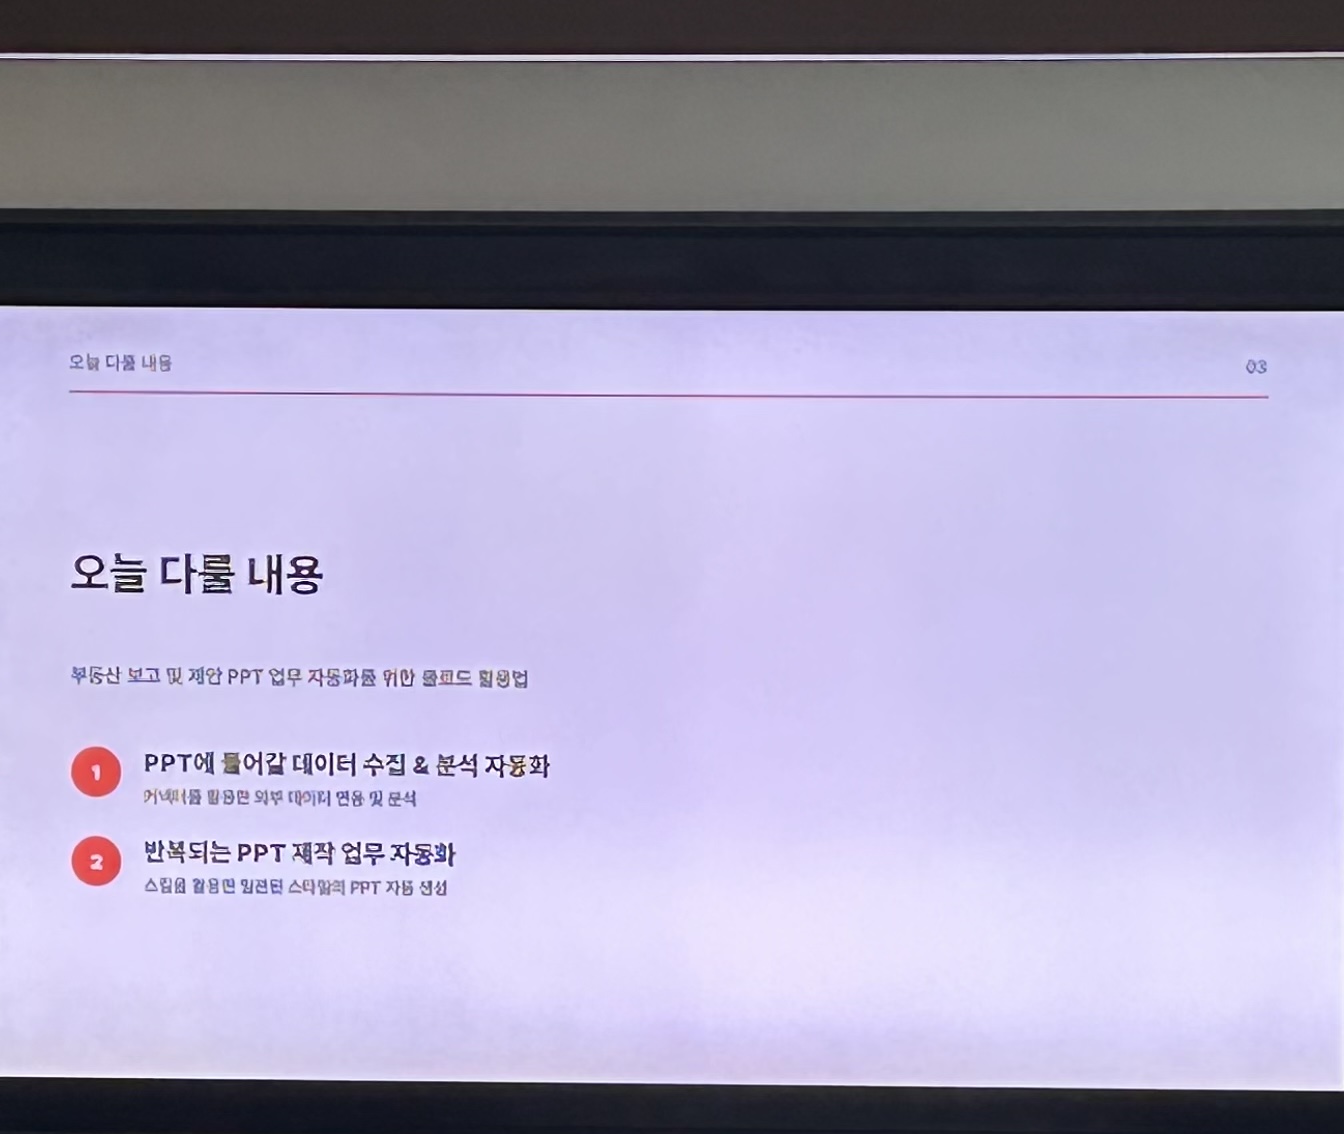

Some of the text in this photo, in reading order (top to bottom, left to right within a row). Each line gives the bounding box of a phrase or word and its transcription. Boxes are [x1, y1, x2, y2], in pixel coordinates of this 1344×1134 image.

[69, 353, 172, 372] 오늘 다룰 내용
[1246, 359, 1267, 374] 03
[71, 553, 323, 595] 오늘 다룰 내용
[71, 666, 122, 685] 부동산
[127, 667, 161, 683] 보고
[166, 667, 183, 685] 및
[188, 666, 223, 685] 제안
[228, 669, 263, 684] PPT
[268, 667, 303, 687] 업무
[308, 668, 376, 687] 자동화를
[383, 668, 415, 687] 위한
[91, 764, 101, 781] 1
[144, 752, 550, 778] PPT에 들어갈 데이터 수집 & 분석 자동화
[289, 790, 331, 807] 데이터
[369, 790, 383, 807] 및
[388, 790, 416, 807] 분석
[90, 854, 103, 870] 2
[145, 840, 456, 867] 반복되는 PPT 제작 업무 자동화
[351, 880, 380, 895] PPT
[386, 880, 414, 896] 자동
